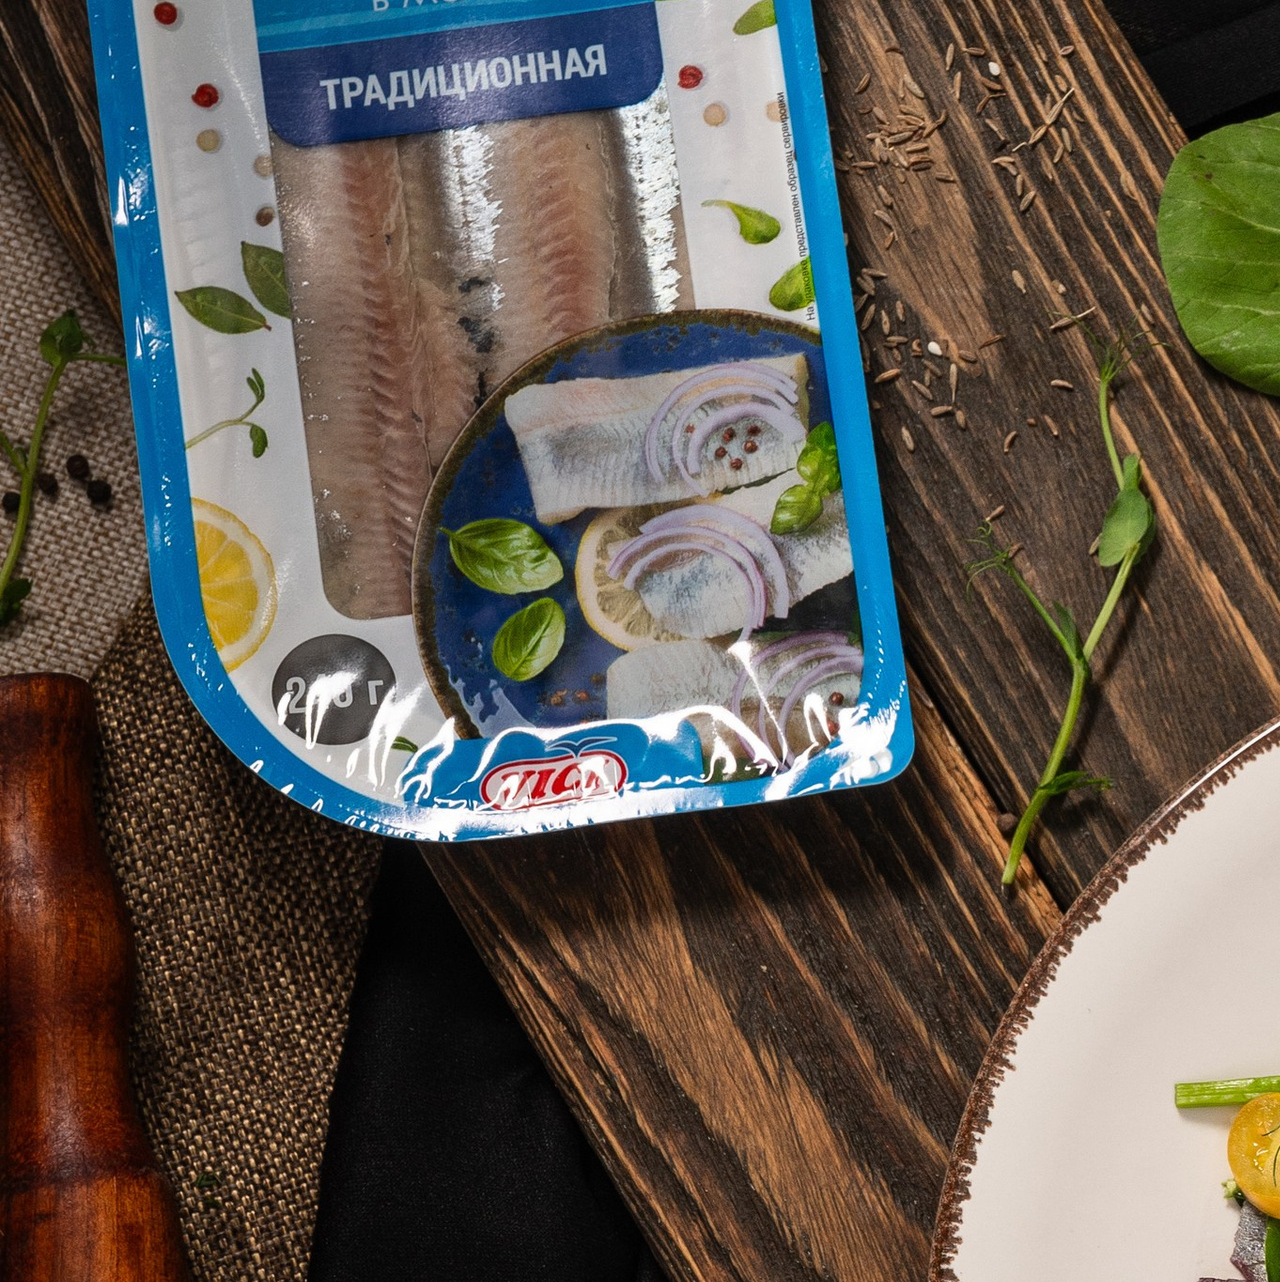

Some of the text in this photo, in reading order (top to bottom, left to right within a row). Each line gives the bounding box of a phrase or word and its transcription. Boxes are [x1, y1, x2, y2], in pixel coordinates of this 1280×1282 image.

[319, 43, 608, 111] ТРАДИЦИОННАЯ
[776, 91, 792, 150] сервировки
[784, 150, 798, 192] образец
[790, 194, 808, 258] представлен
[805, 305, 816, 321] На
[285, 673, 384, 715] 20 г
